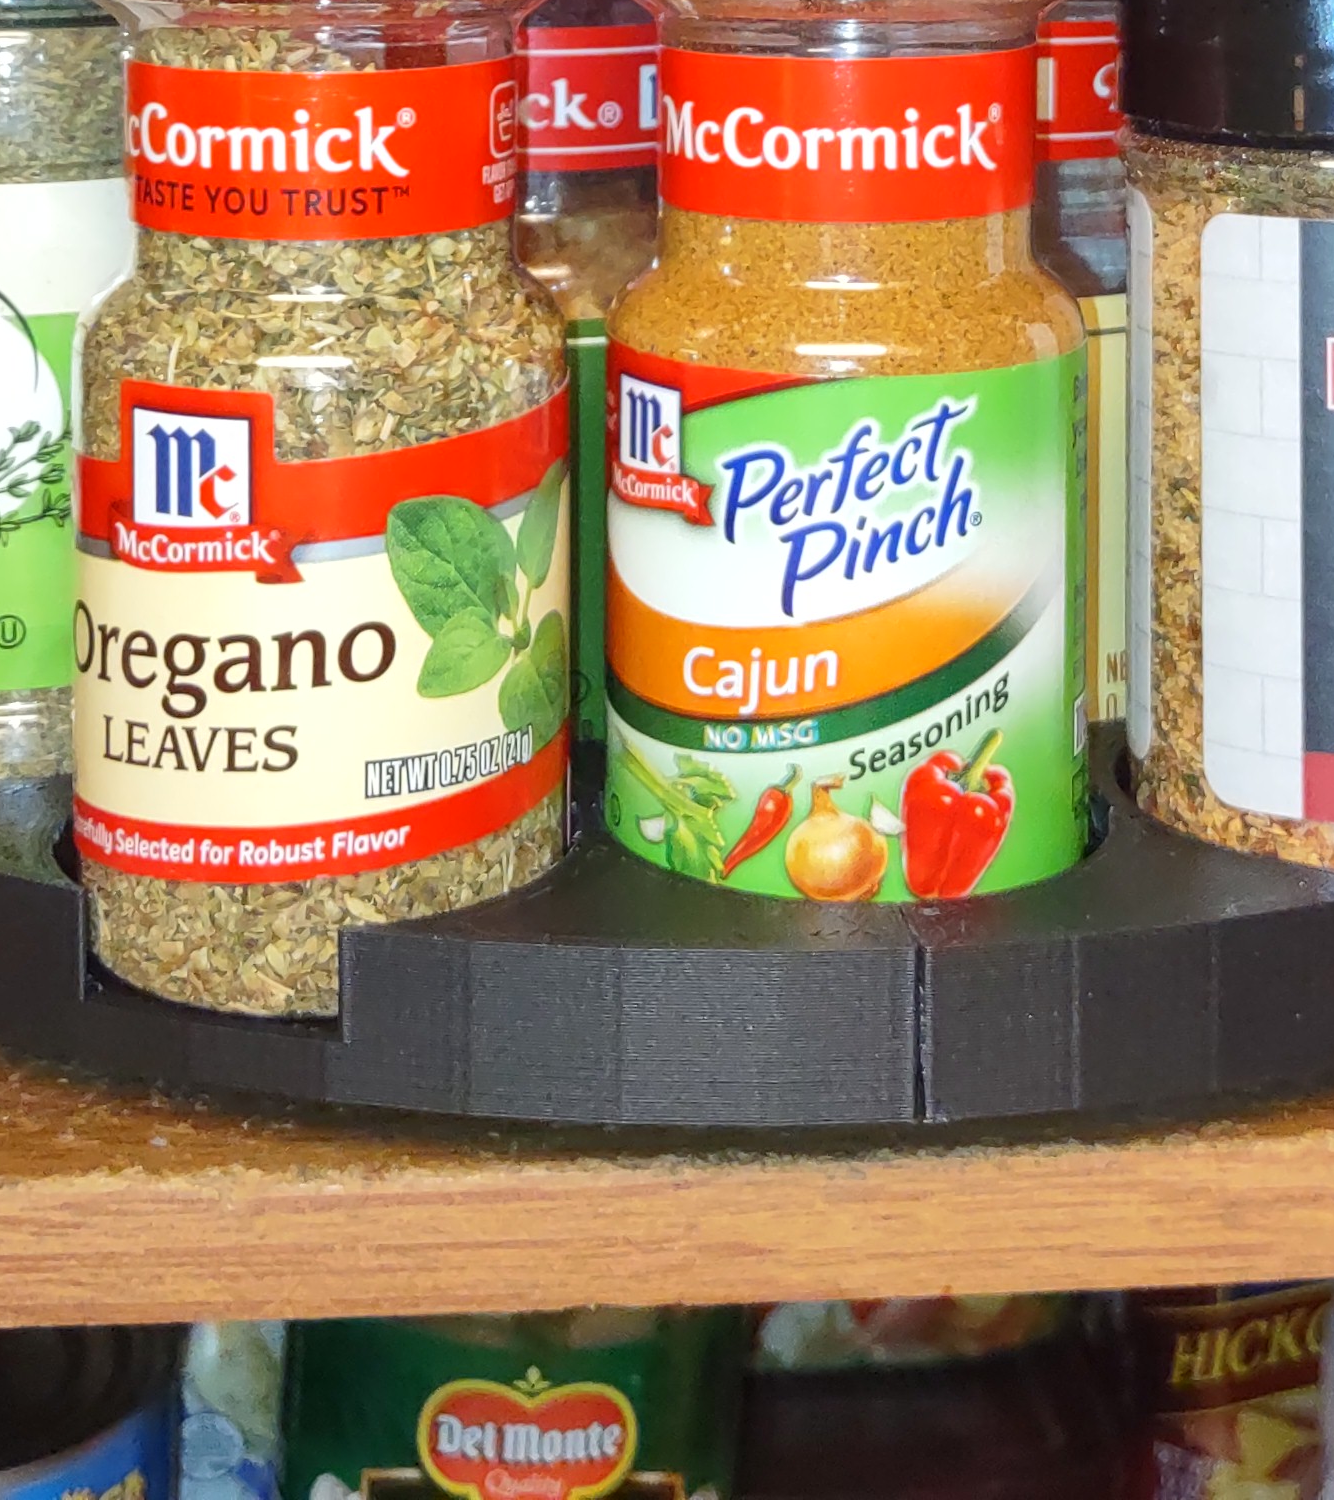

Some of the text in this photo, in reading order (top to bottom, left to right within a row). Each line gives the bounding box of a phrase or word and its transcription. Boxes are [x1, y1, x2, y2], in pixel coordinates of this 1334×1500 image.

[126, 100, 411, 178] cCormick
[663, 94, 998, 172] McCormick
[134, 175, 391, 218] TASTE YOU TRUST
[612, 465, 697, 509] McCormick
[722, 402, 970, 545] Perfect
[115, 521, 276, 565] McCormick
[779, 455, 974, 618] Pinch
[72, 598, 398, 720] Oregano
[682, 645, 839, 714] Cajun
[102, 715, 300, 775] LEAVES
[364, 722, 534, 799] NET WT 0.75 OZ (21g)
[704, 721, 819, 751] NO MSG
[848, 670, 1011, 782] Seasoning
[116, 823, 411, 868] Selected for Robust Flavor
[435, 1414, 624, 1465] Del Monte
